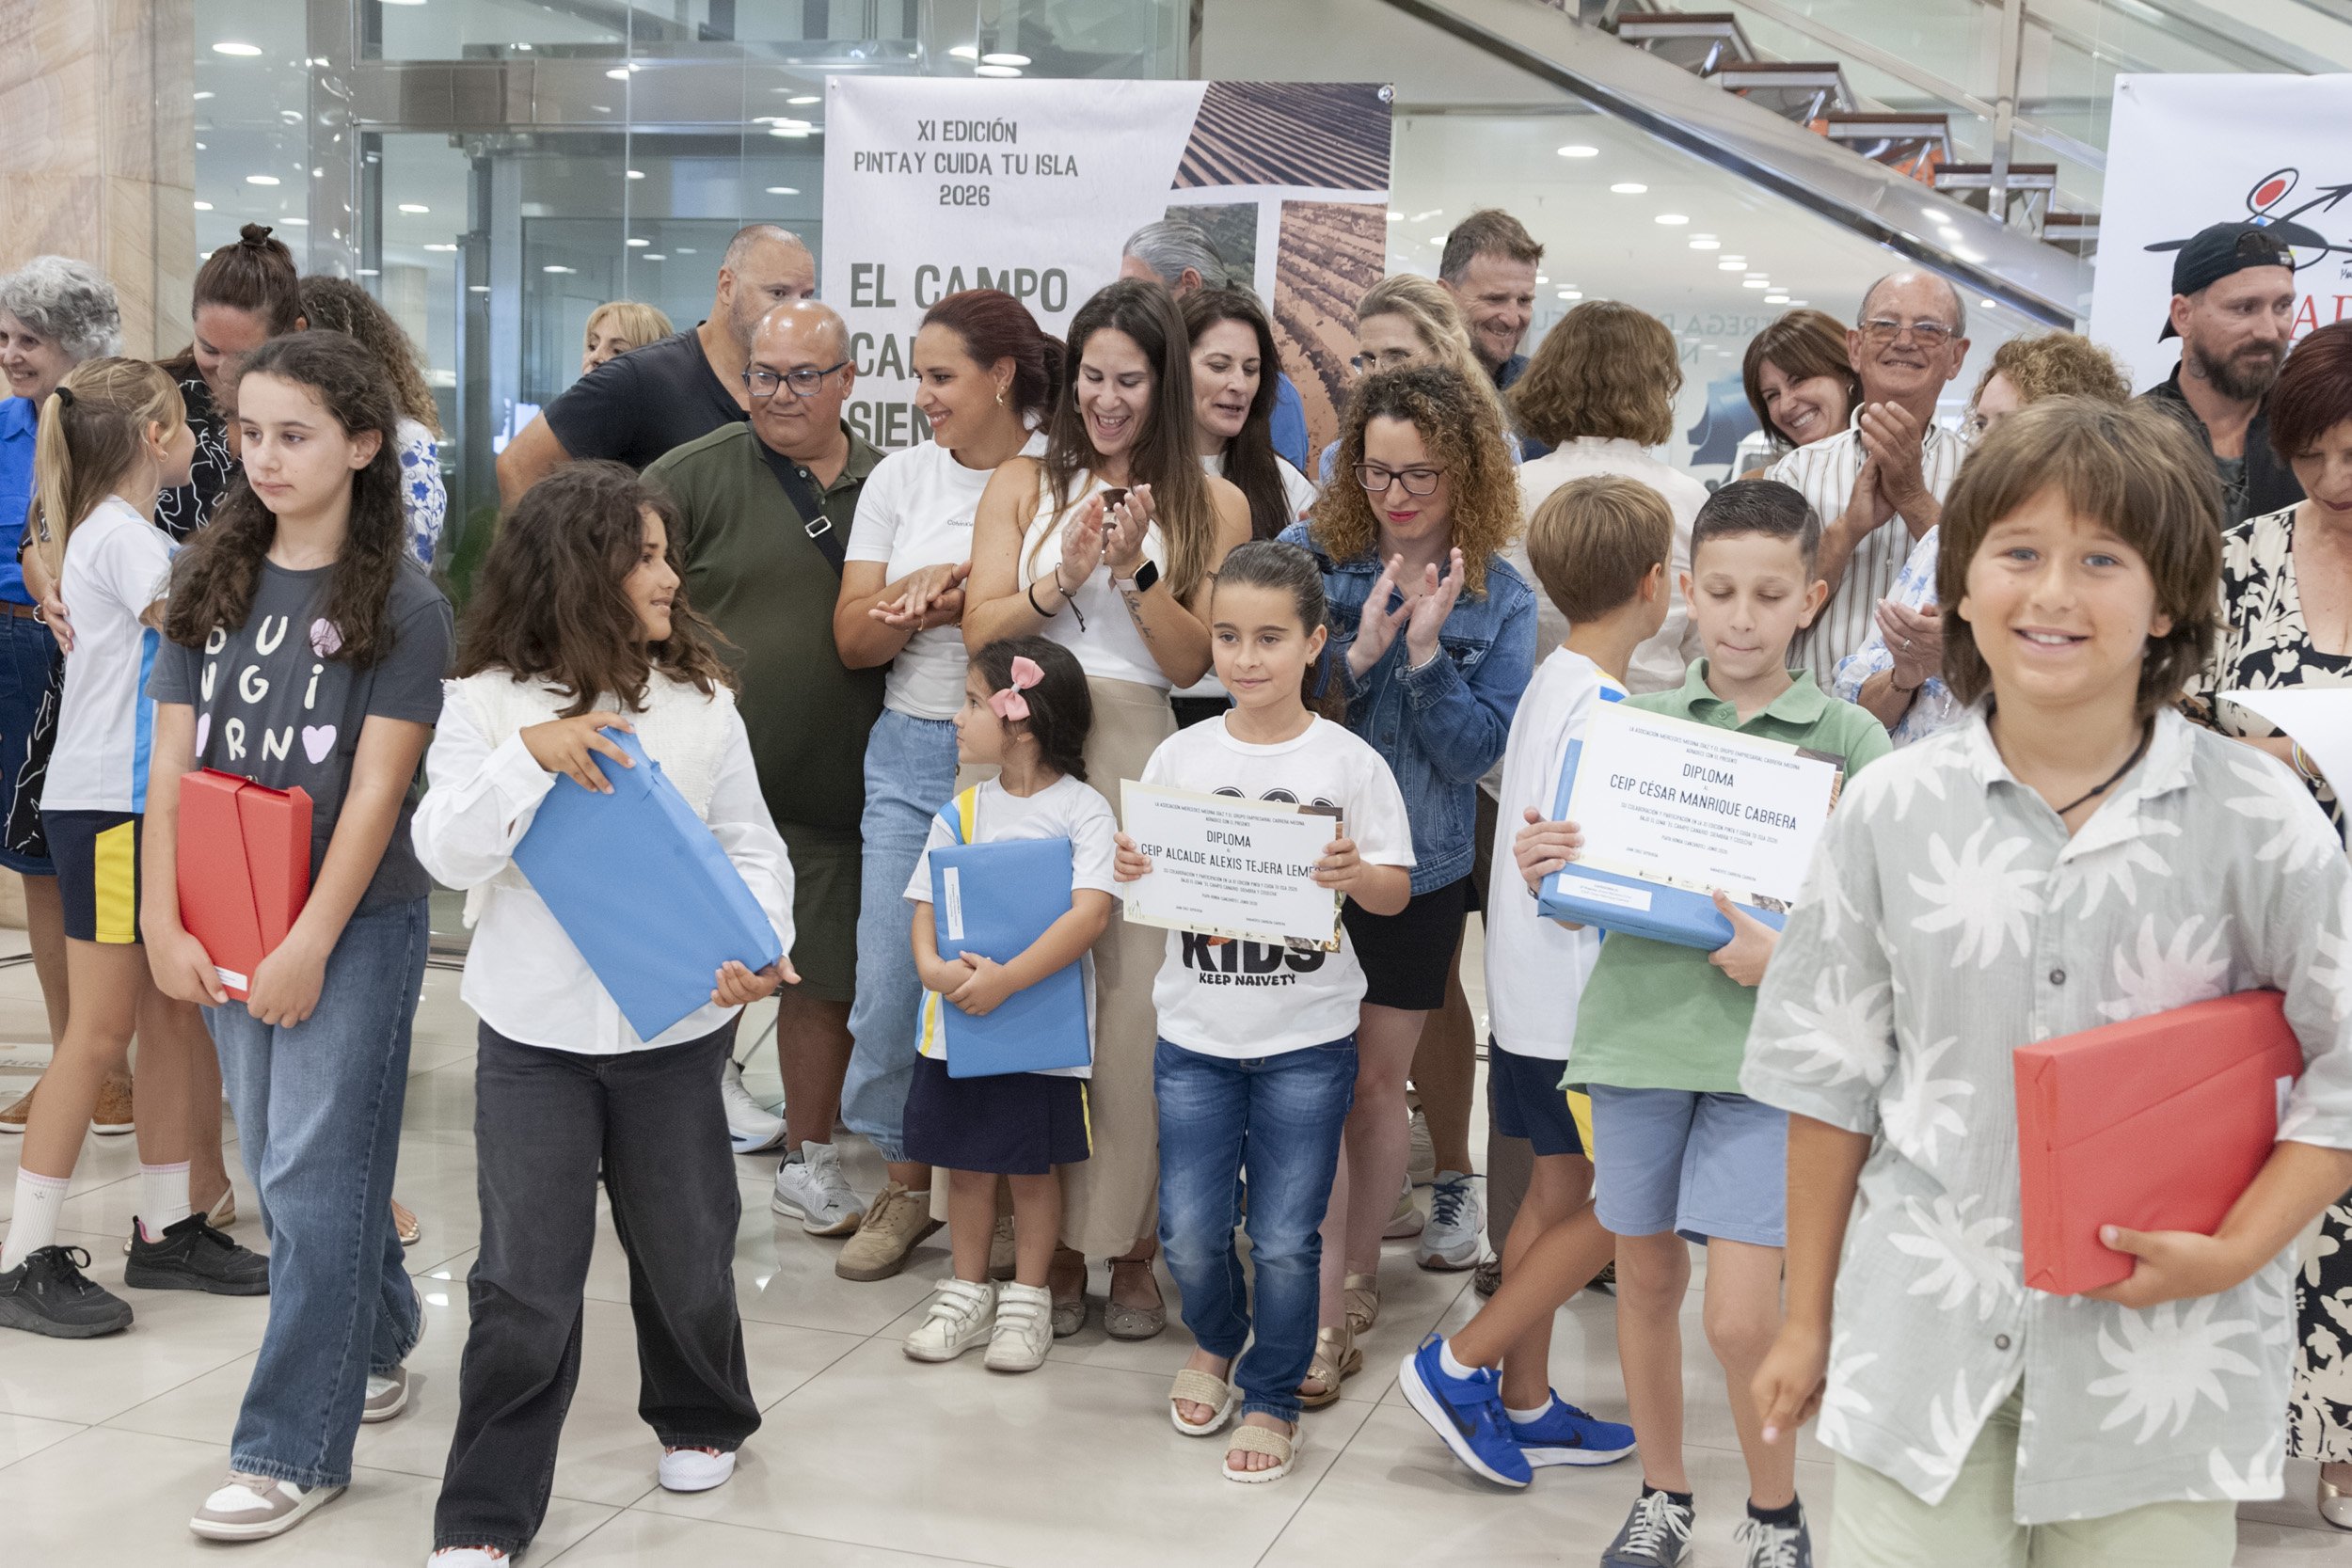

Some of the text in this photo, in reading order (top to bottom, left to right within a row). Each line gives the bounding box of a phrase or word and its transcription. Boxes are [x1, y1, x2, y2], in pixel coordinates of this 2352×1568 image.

[917, 118, 1017, 144] XI EDICIÓN
[934, 152, 993, 175] CUIDA
[1001, 153, 1028, 175] TU
[1036, 154, 1078, 177] ISLA
[939, 184, 990, 207] 2026
[850, 263, 897, 308] EL
[1683, 763, 1734, 787] DIPLOMA
[1610, 774, 1796, 831] CEIP CÉSAR MANRIQUE CABRERA
[1207, 831, 1251, 847] DIPLOMA
[1141, 844, 1320, 878] CEIP ALCALDE ALEXIS TEJERA LEM
[1200, 973, 1295, 986] KEEP NAIVETY
